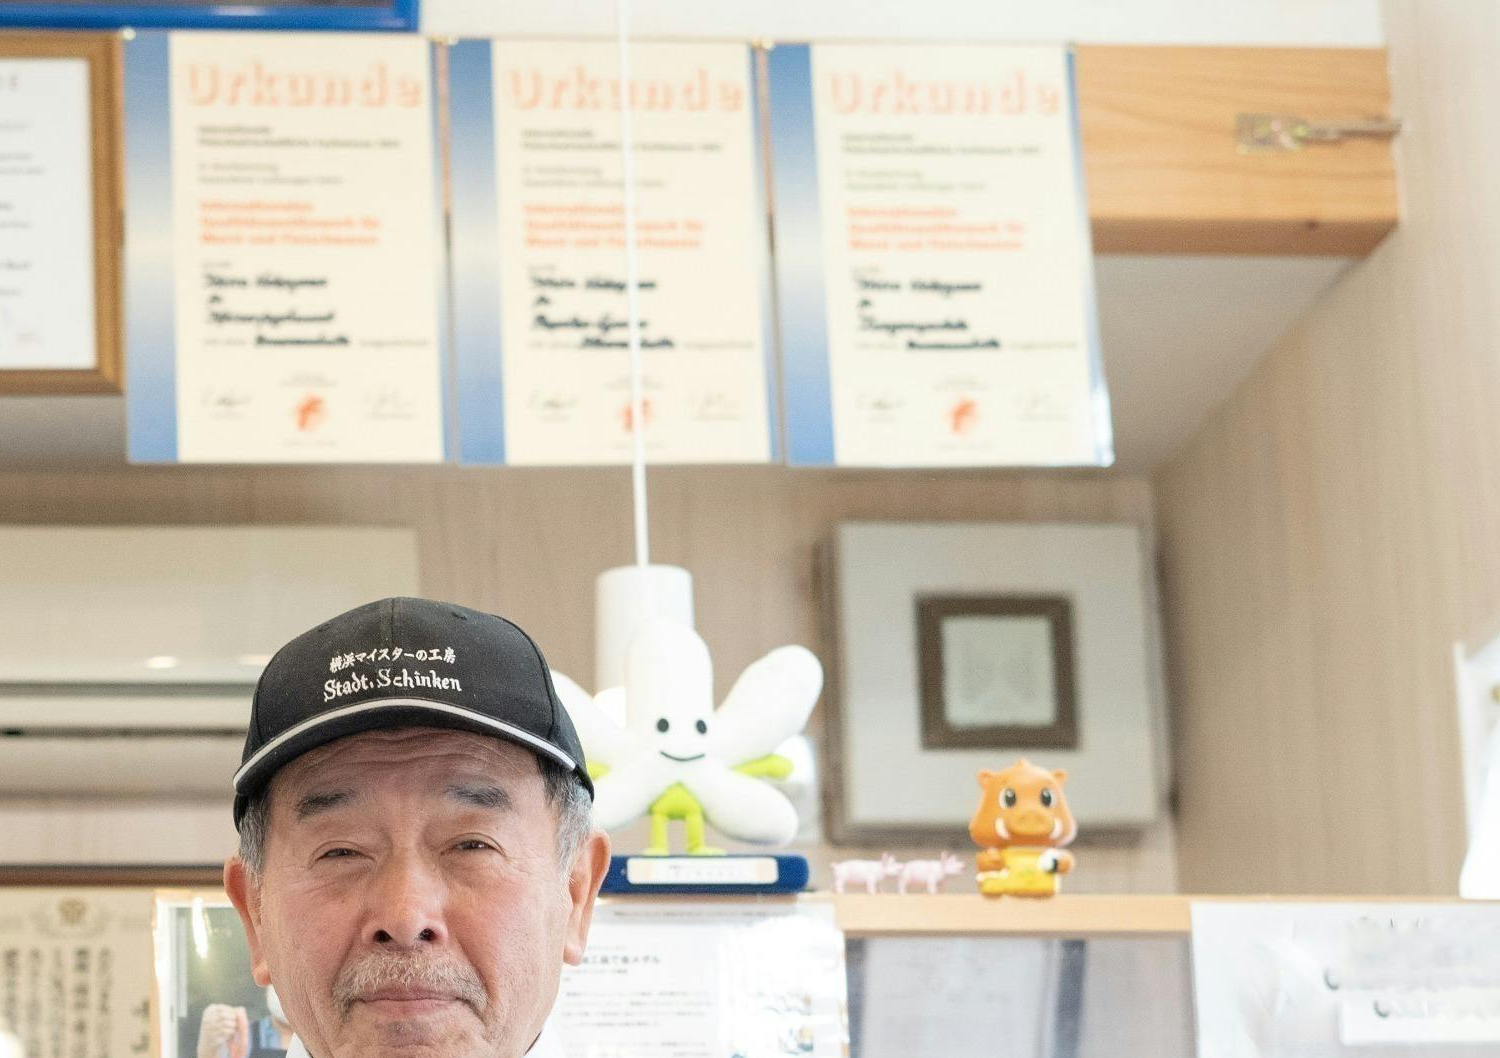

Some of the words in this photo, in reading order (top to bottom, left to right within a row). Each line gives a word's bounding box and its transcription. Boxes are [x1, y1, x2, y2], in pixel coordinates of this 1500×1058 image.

[186, 62, 423, 108] Urkunde
[507, 65, 743, 112] Urkunde
[829, 69, 1061, 116] Urkunde
[329, 646, 456, 673] 横浜マイスターの工房
